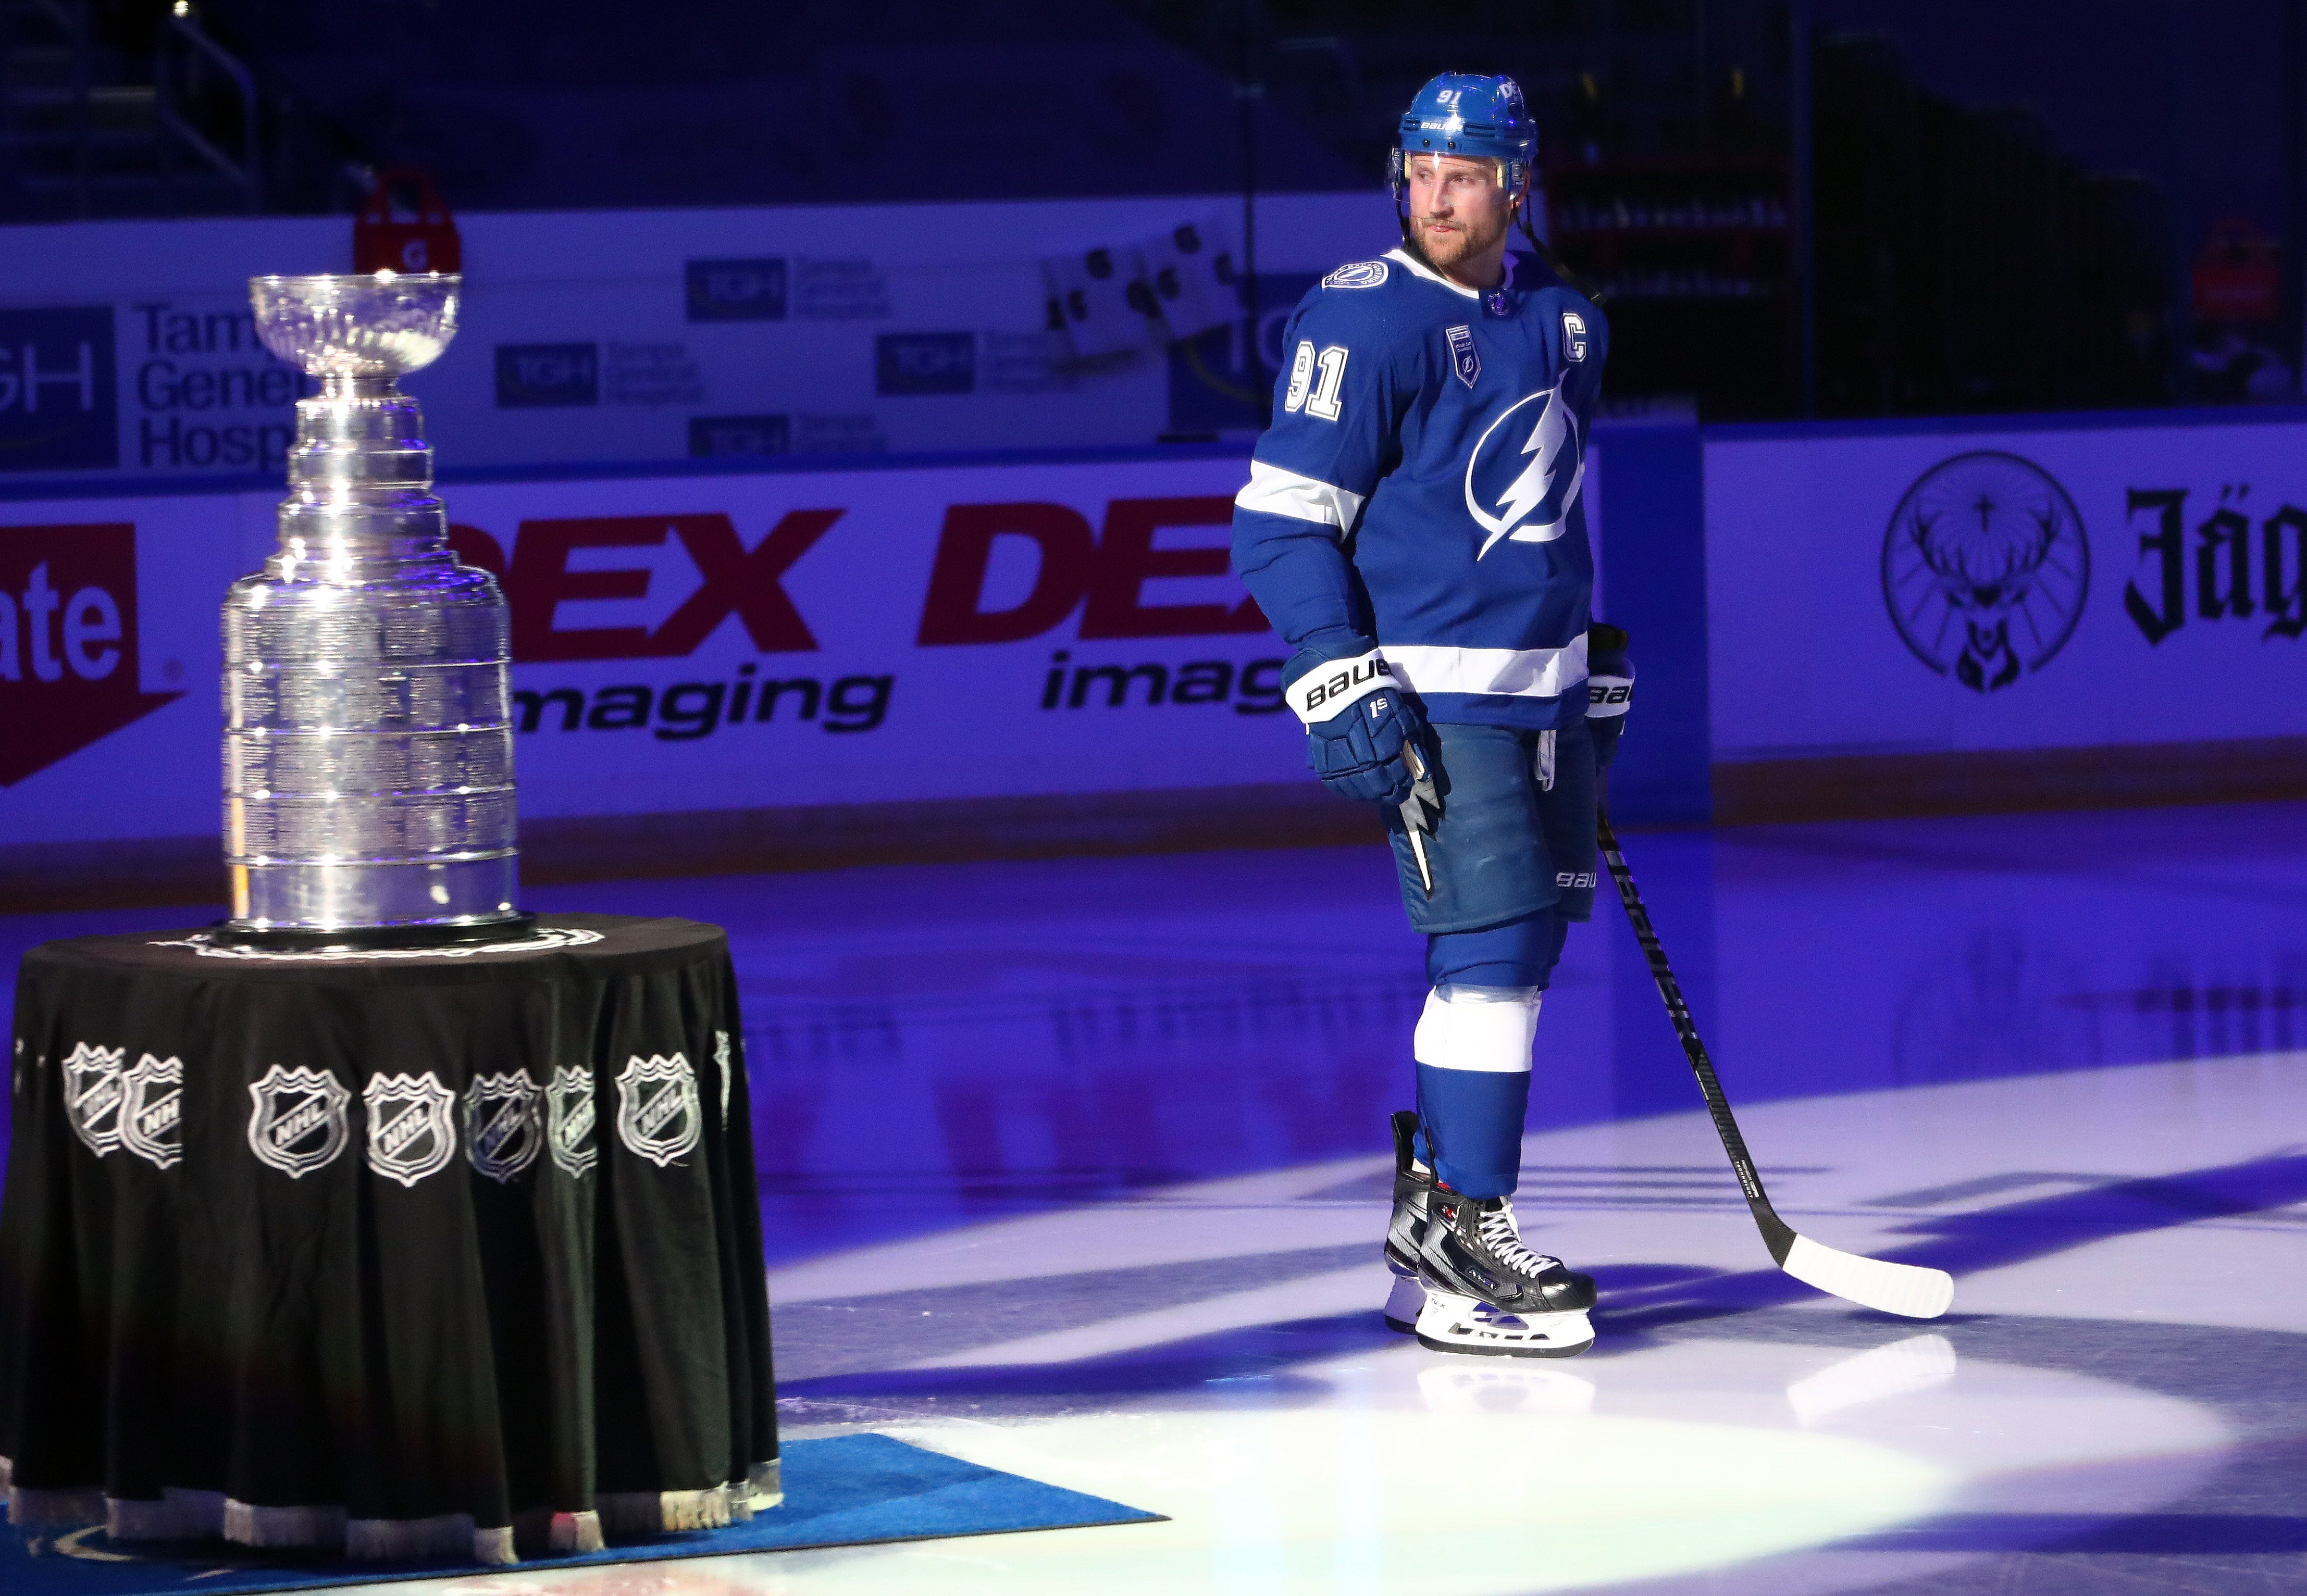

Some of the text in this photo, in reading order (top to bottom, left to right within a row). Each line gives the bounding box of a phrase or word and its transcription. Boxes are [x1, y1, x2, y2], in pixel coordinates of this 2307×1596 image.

[1436, 90, 1461, 105] 91
[132, 302, 262, 355] Tam
[1562, 313, 1587, 362] C
[1285, 341, 1349, 421] 91
[446, 507, 848, 664] EX
[915, 495, 1272, 647] DE
[276, 1102, 324, 1145] NHL
[384, 1108, 428, 1152] NHL
[642, 1088, 681, 1136] NHL
[1431, 1298, 1446, 1308] TUK
